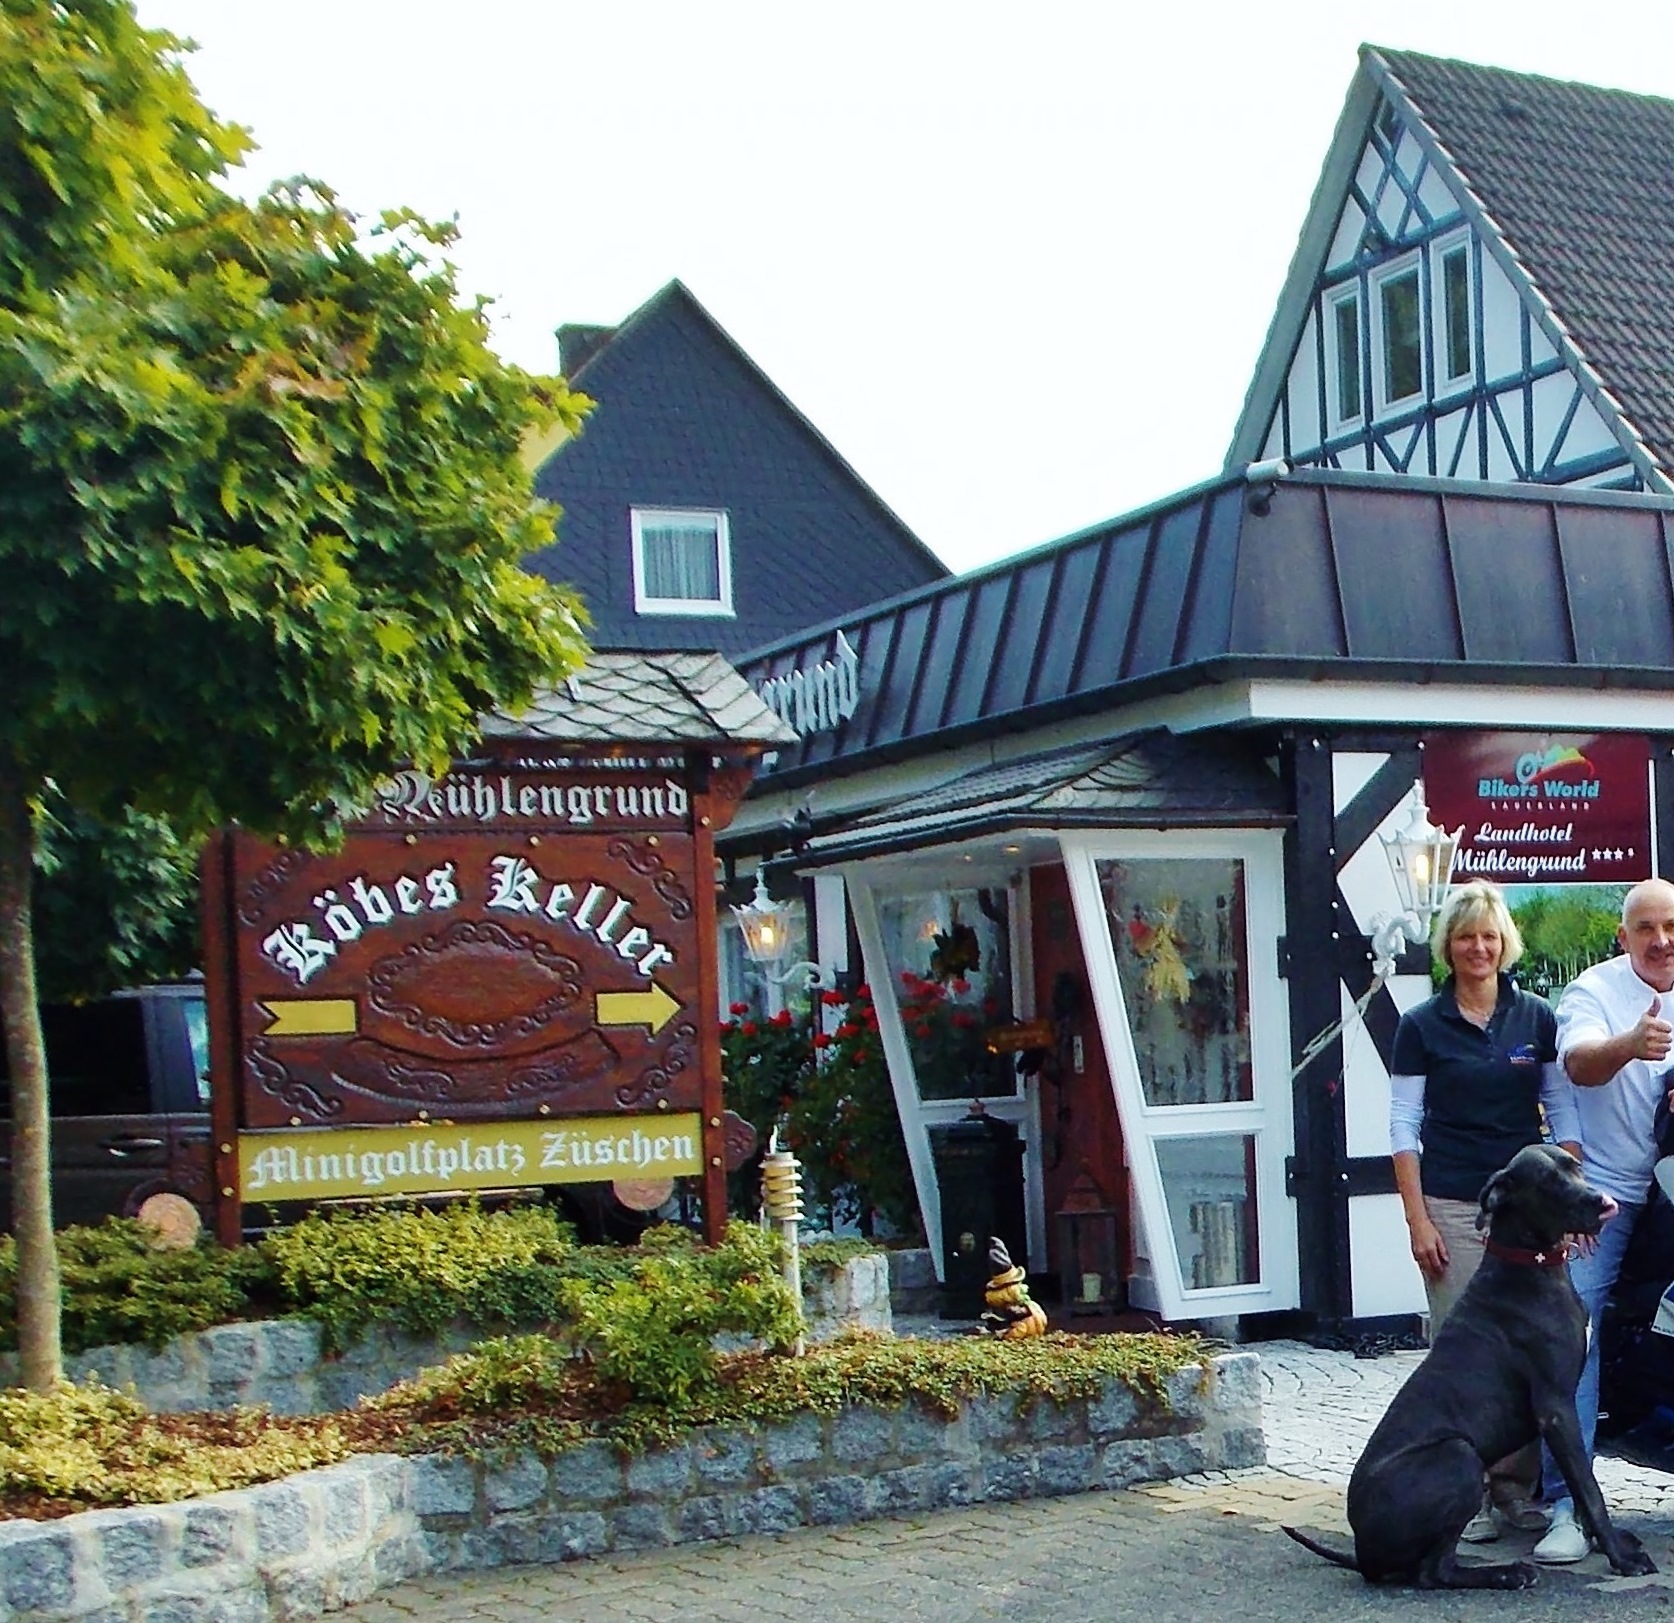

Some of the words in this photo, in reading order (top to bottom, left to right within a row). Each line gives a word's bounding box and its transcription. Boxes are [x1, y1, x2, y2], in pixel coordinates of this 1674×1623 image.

[374, 770, 688, 825] Mühlengrund
[1478, 778, 1538, 798] Bikers
[1544, 779, 1600, 798] World
[1491, 801, 1590, 811] SAUERLAND
[1473, 822, 1573, 843] Landhotel
[1451, 847, 1586, 878] Mühlengrund
[261, 860, 460, 984] Köbes
[487, 854, 676, 978] Keller
[247, 1138, 526, 1190] Minigolfplatz
[539, 1129, 695, 1169] Züschen
